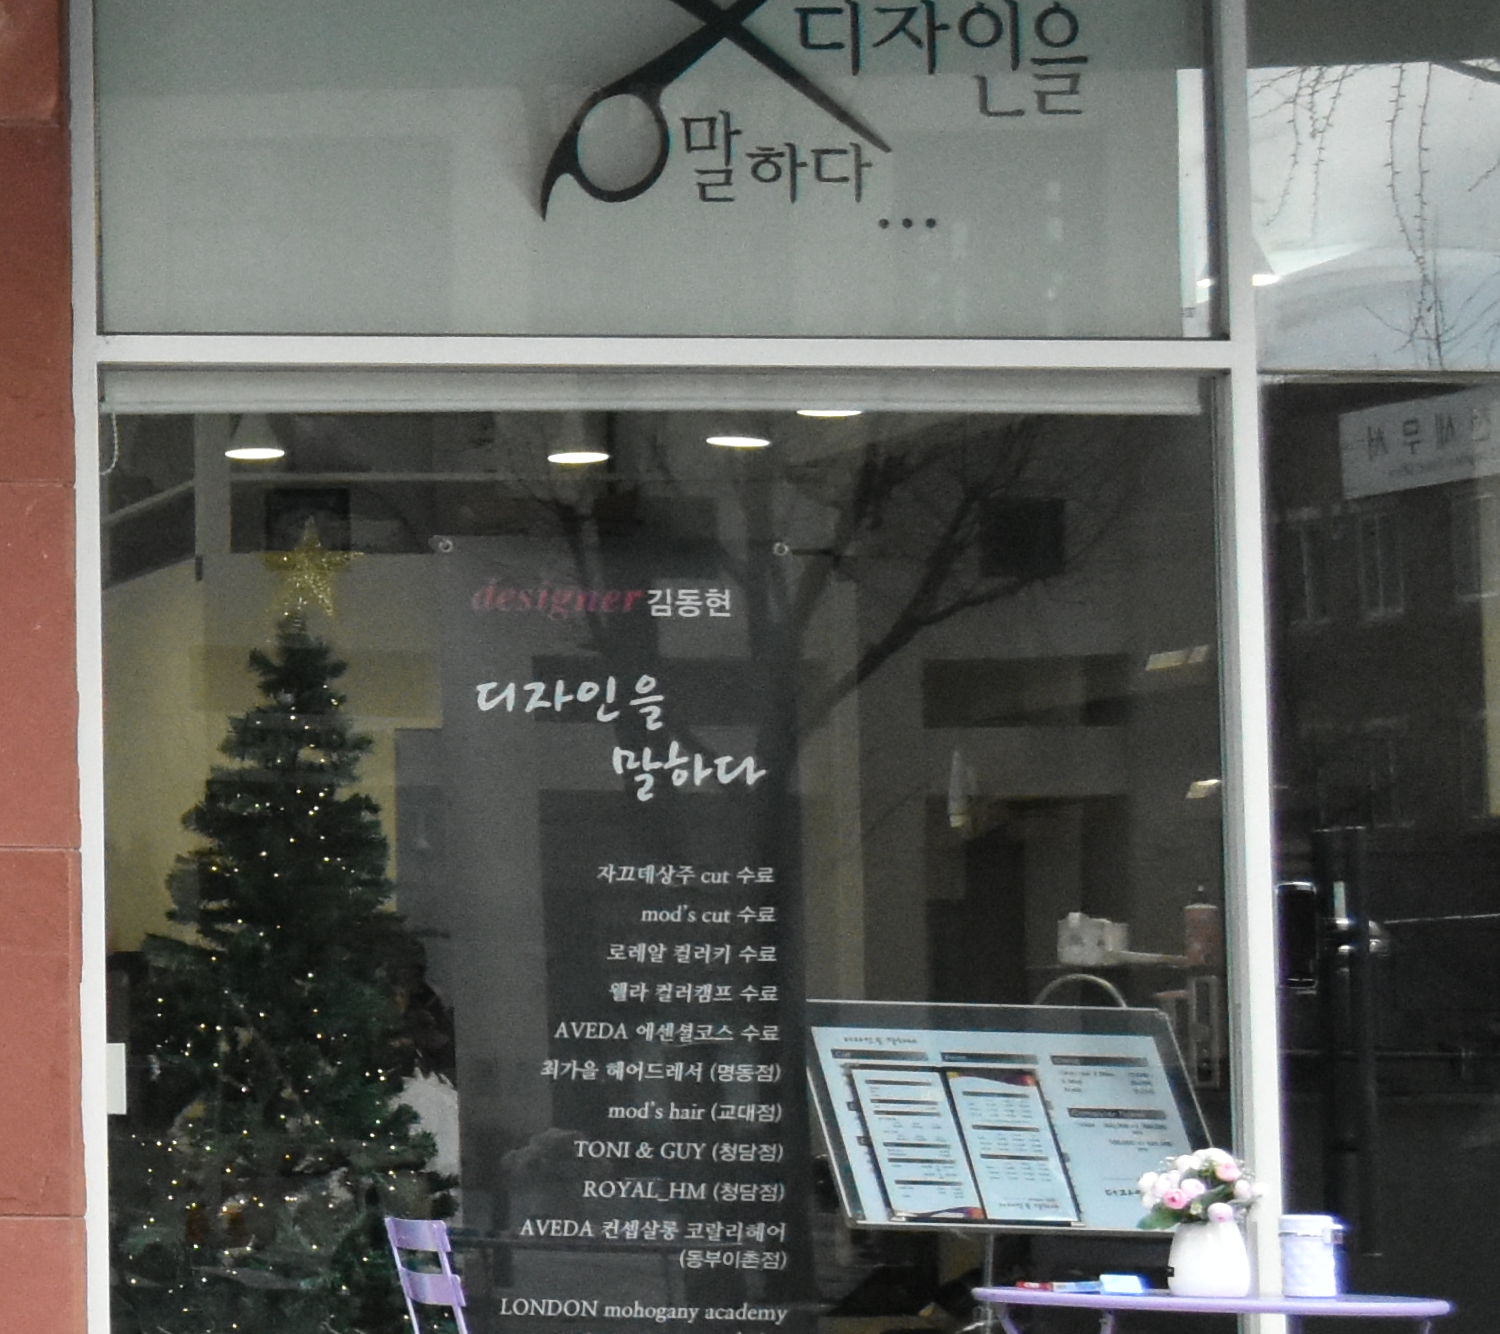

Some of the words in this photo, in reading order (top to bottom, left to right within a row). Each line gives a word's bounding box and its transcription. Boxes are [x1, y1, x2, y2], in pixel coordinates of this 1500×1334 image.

[471, 583, 644, 619] designer
[647, 588, 732, 617] 김동현
[476, 674, 664, 731] 디자인을
[612, 740, 767, 801] 말하다
[701, 869, 730, 883] cut
[736, 866, 775, 884] 수료
[641, 904, 696, 922] mod's
[702, 909, 730, 923] cut
[736, 906, 776, 923] 수료
[607, 943, 667, 963] 로레알
[674, 944, 730, 964] 컬러키
[738, 945, 777, 963] 수료
[655, 983, 732, 1003] 컬러캠프
[740, 985, 779, 1003] 수료
[554, 1022, 628, 1040] AVEDA
[636, 1022, 734, 1042] 에센셜코스
[741, 1025, 780, 1041] 수료
[540, 1060, 599, 1080] 최가을
[606, 1062, 702, 1082] 헤어드레서
[710, 1064, 781, 1082] (명동점)
[608, 1102, 663, 1119] mod's
[669, 1102, 706, 1120] hair
[711, 1103, 782, 1122] (교대점)
[574, 1141, 630, 1159] TONI
[636, 1142, 653, 1158] &
[660, 1143, 706, 1160] GUY
[712, 1143, 784, 1162] (청담점)
[582, 1180, 706, 1202] ROYAL_HM
[713, 1182, 785, 1202] (청담점)
[519, 1219, 594, 1237] AVEDA
[601, 1219, 679, 1240] 컨셉살롱
[684, 1222, 786, 1242] 코랄리헤어
[680, 1249, 787, 1270] (동부이촌점)
[500, 1298, 598, 1316] LONDON
[604, 1301, 699, 1324] mohogany
[705, 1302, 788, 1325] academy
